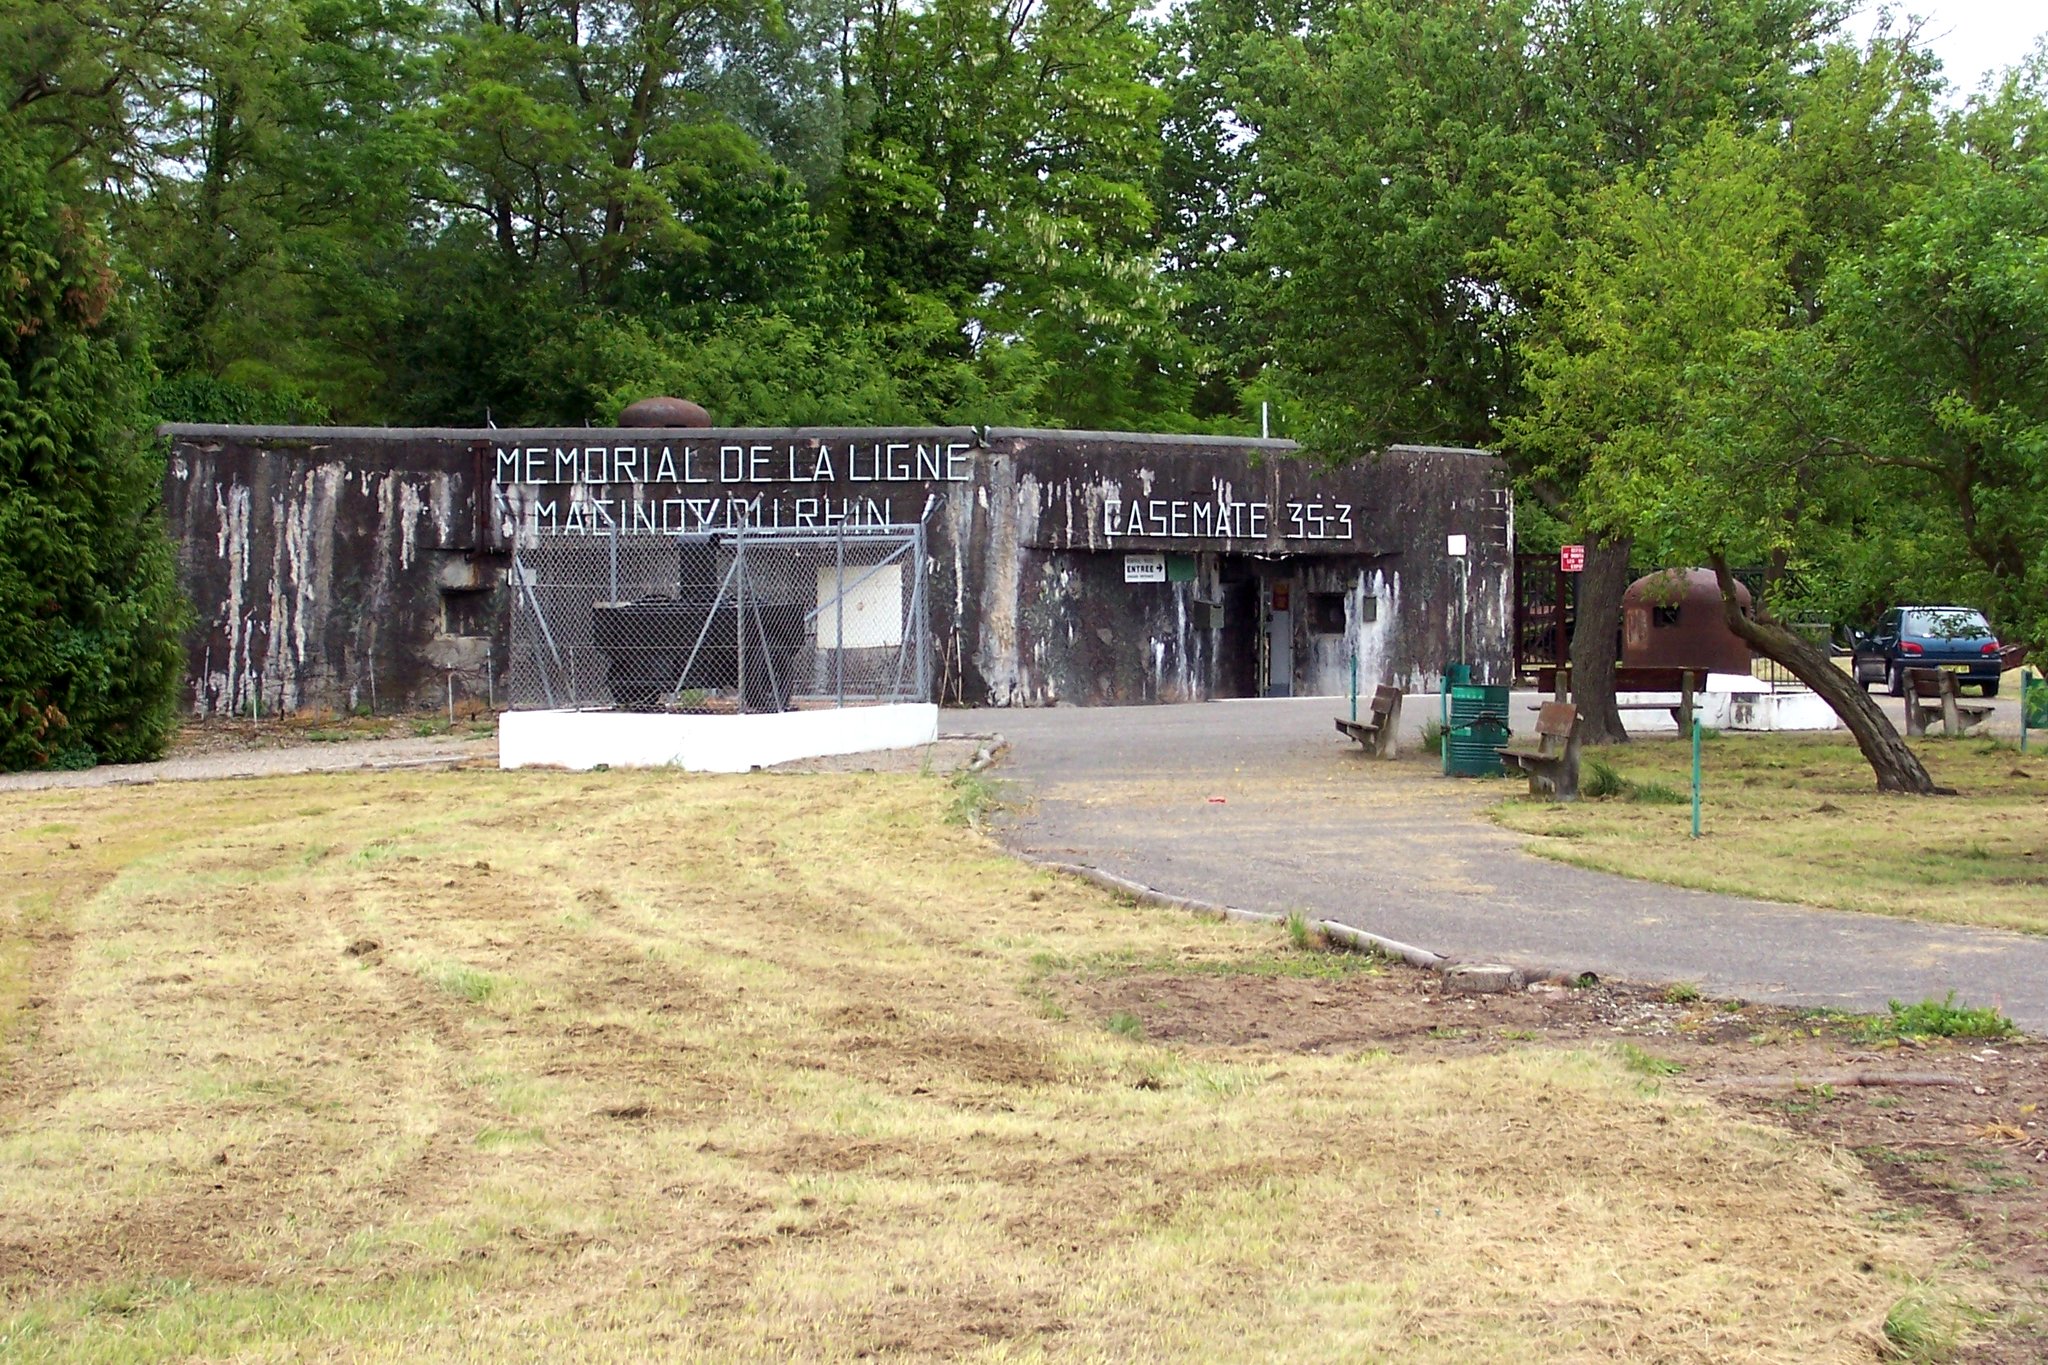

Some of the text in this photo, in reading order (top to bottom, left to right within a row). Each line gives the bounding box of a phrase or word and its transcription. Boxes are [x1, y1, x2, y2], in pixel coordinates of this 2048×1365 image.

[496, 444, 970, 485] MEMORIAL DE LA LIGNE
[795, 498, 890, 534] RHIN
[1104, 500, 1352, 539] CASEMATE 35-3
